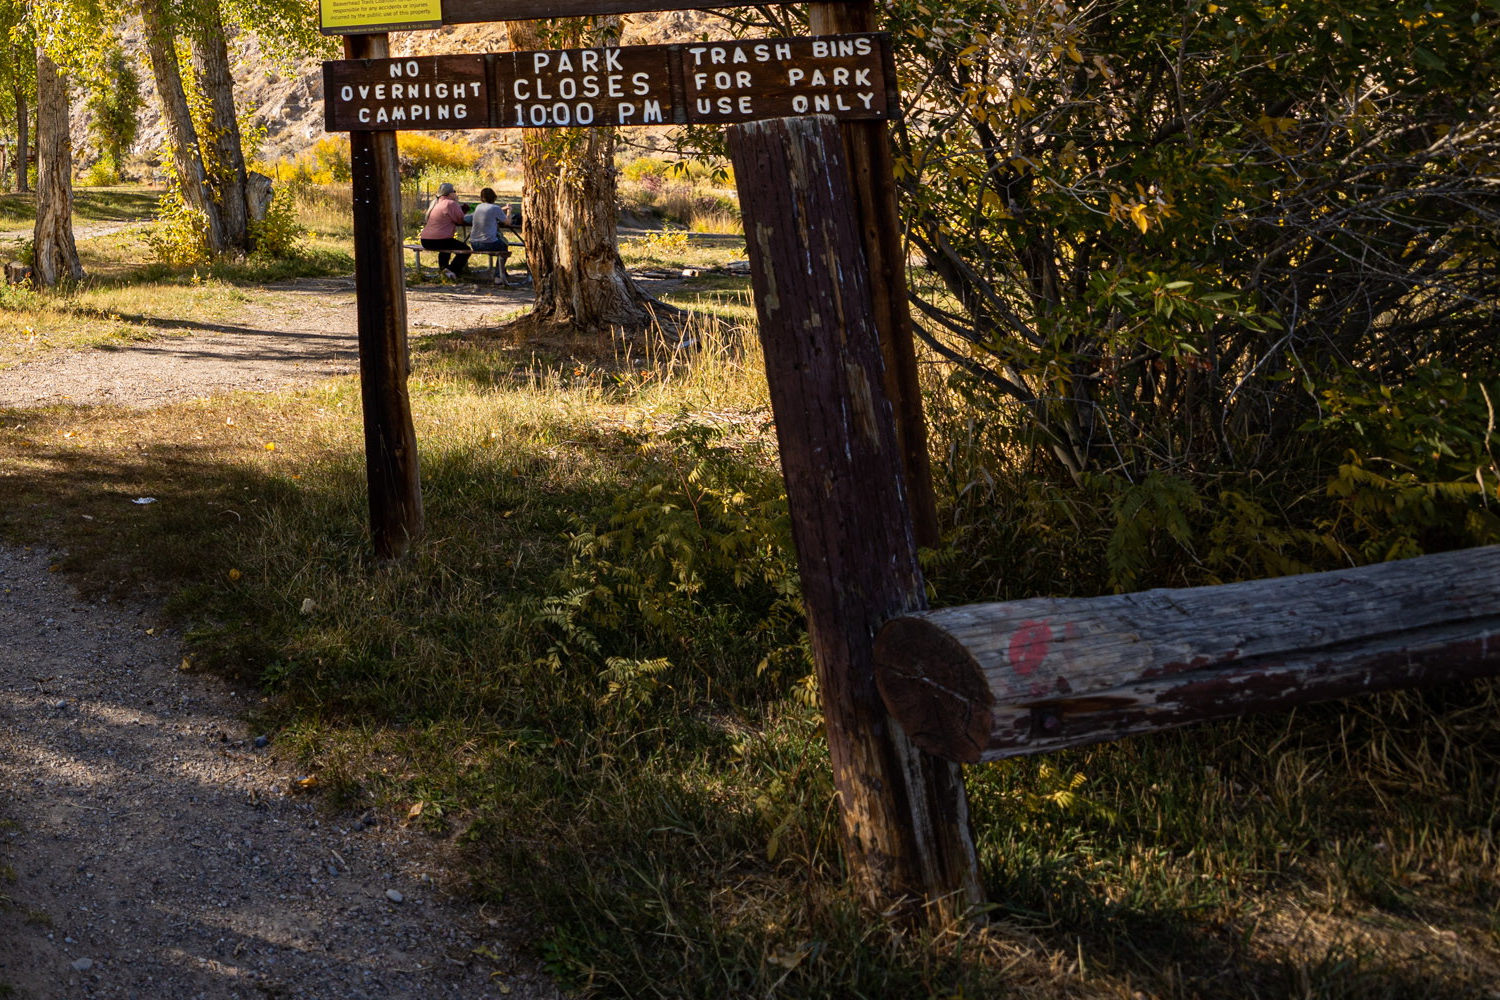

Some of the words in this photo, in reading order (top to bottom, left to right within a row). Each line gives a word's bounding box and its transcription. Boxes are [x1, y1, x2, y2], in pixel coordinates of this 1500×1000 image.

[534, 48, 623, 75] PARK
[689, 43, 793, 66] TRASH
[812, 37, 873, 59] BINS
[390, 60, 419, 79] NO
[694, 70, 752, 91] FOR
[788, 67, 872, 88] PARK
[341, 82, 481, 102] OVERNIGHT
[513, 72, 651, 102] CLOSES
[358, 103, 468, 124] CAMPING
[514, 102, 594, 126] 10:00
[619, 99, 663, 126] PM
[696, 96, 754, 115] USE
